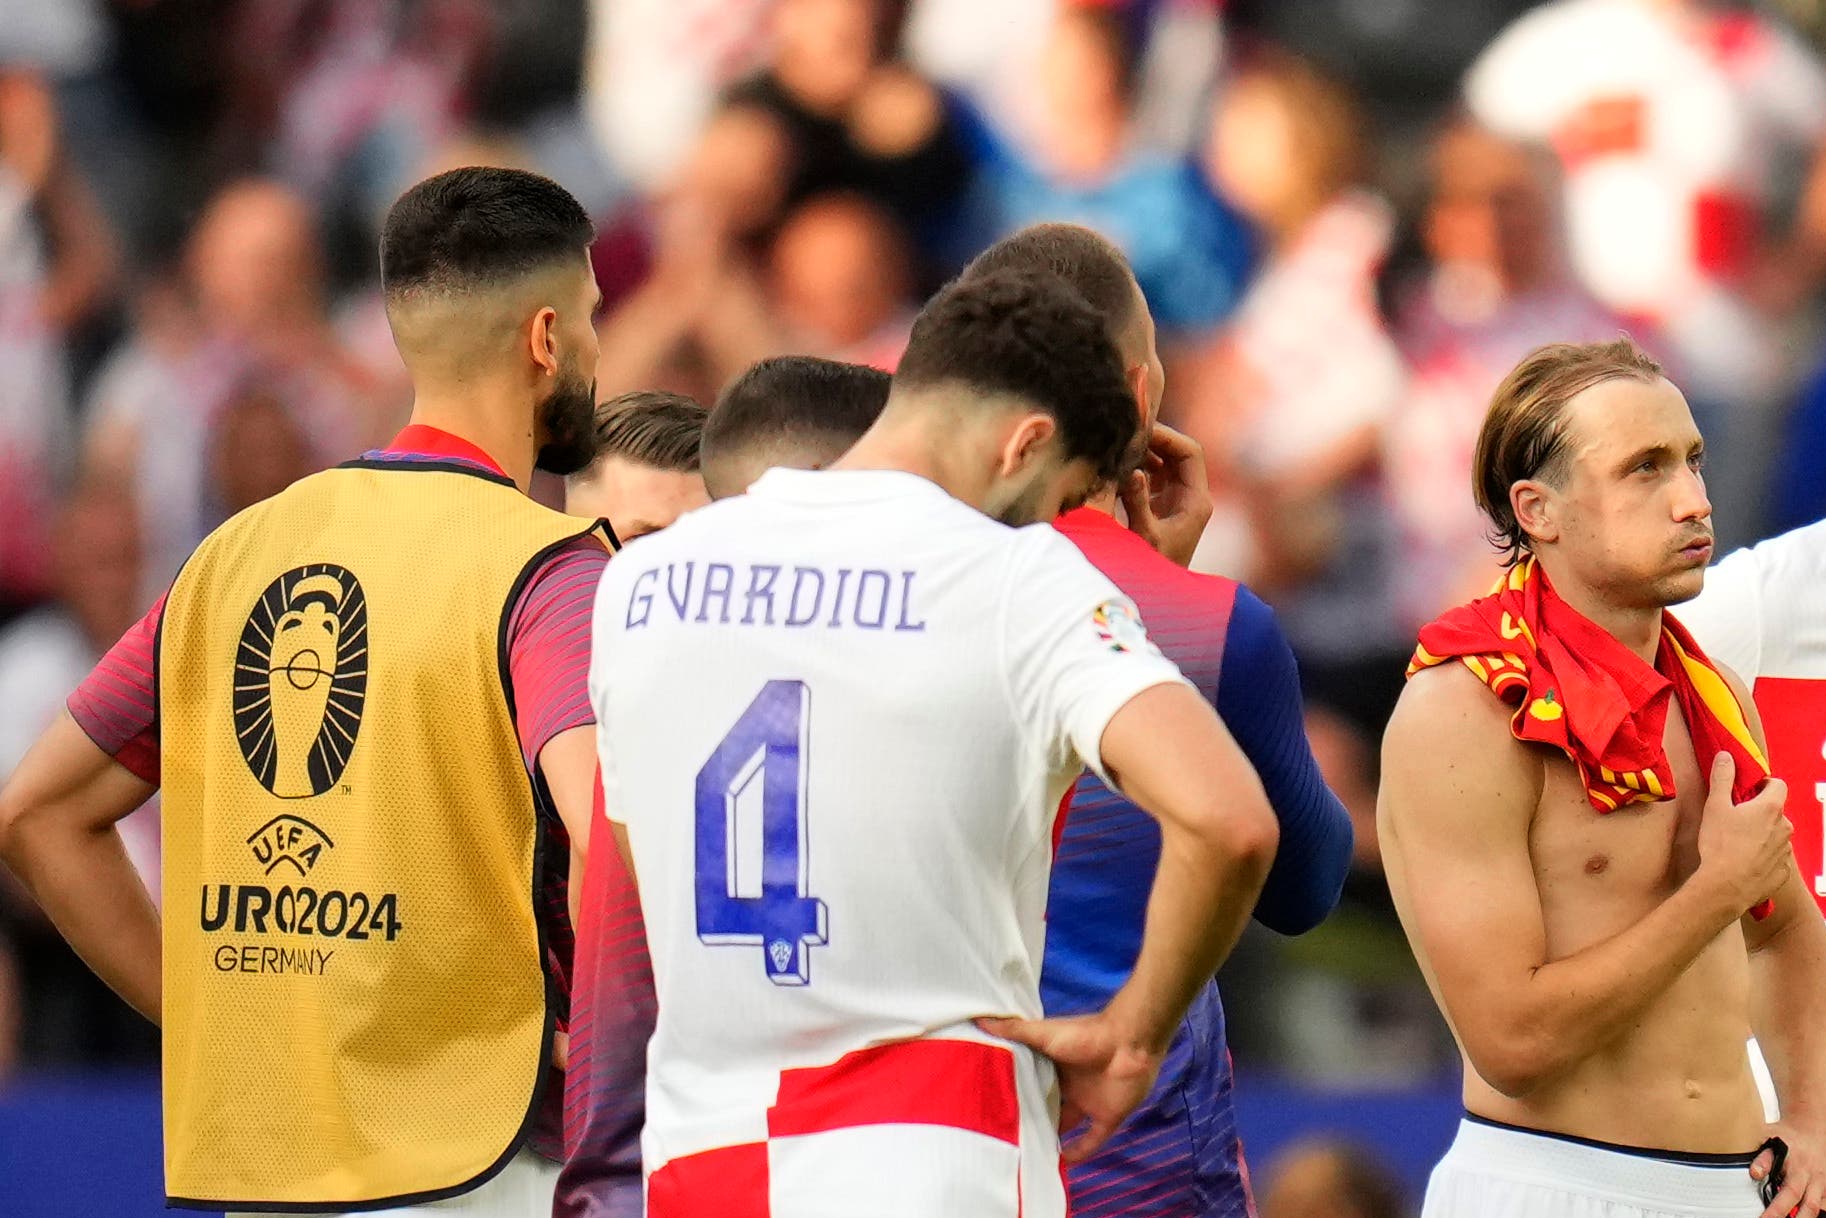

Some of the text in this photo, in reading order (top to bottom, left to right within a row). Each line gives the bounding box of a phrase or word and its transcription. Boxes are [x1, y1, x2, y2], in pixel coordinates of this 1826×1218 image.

[626, 561, 925, 632] GVARDIOL
[252, 825, 322, 870] UEFA
[695, 679, 829, 986] 4
[200, 884, 403, 941] URO2024
[214, 945, 334, 976] GERMANY
